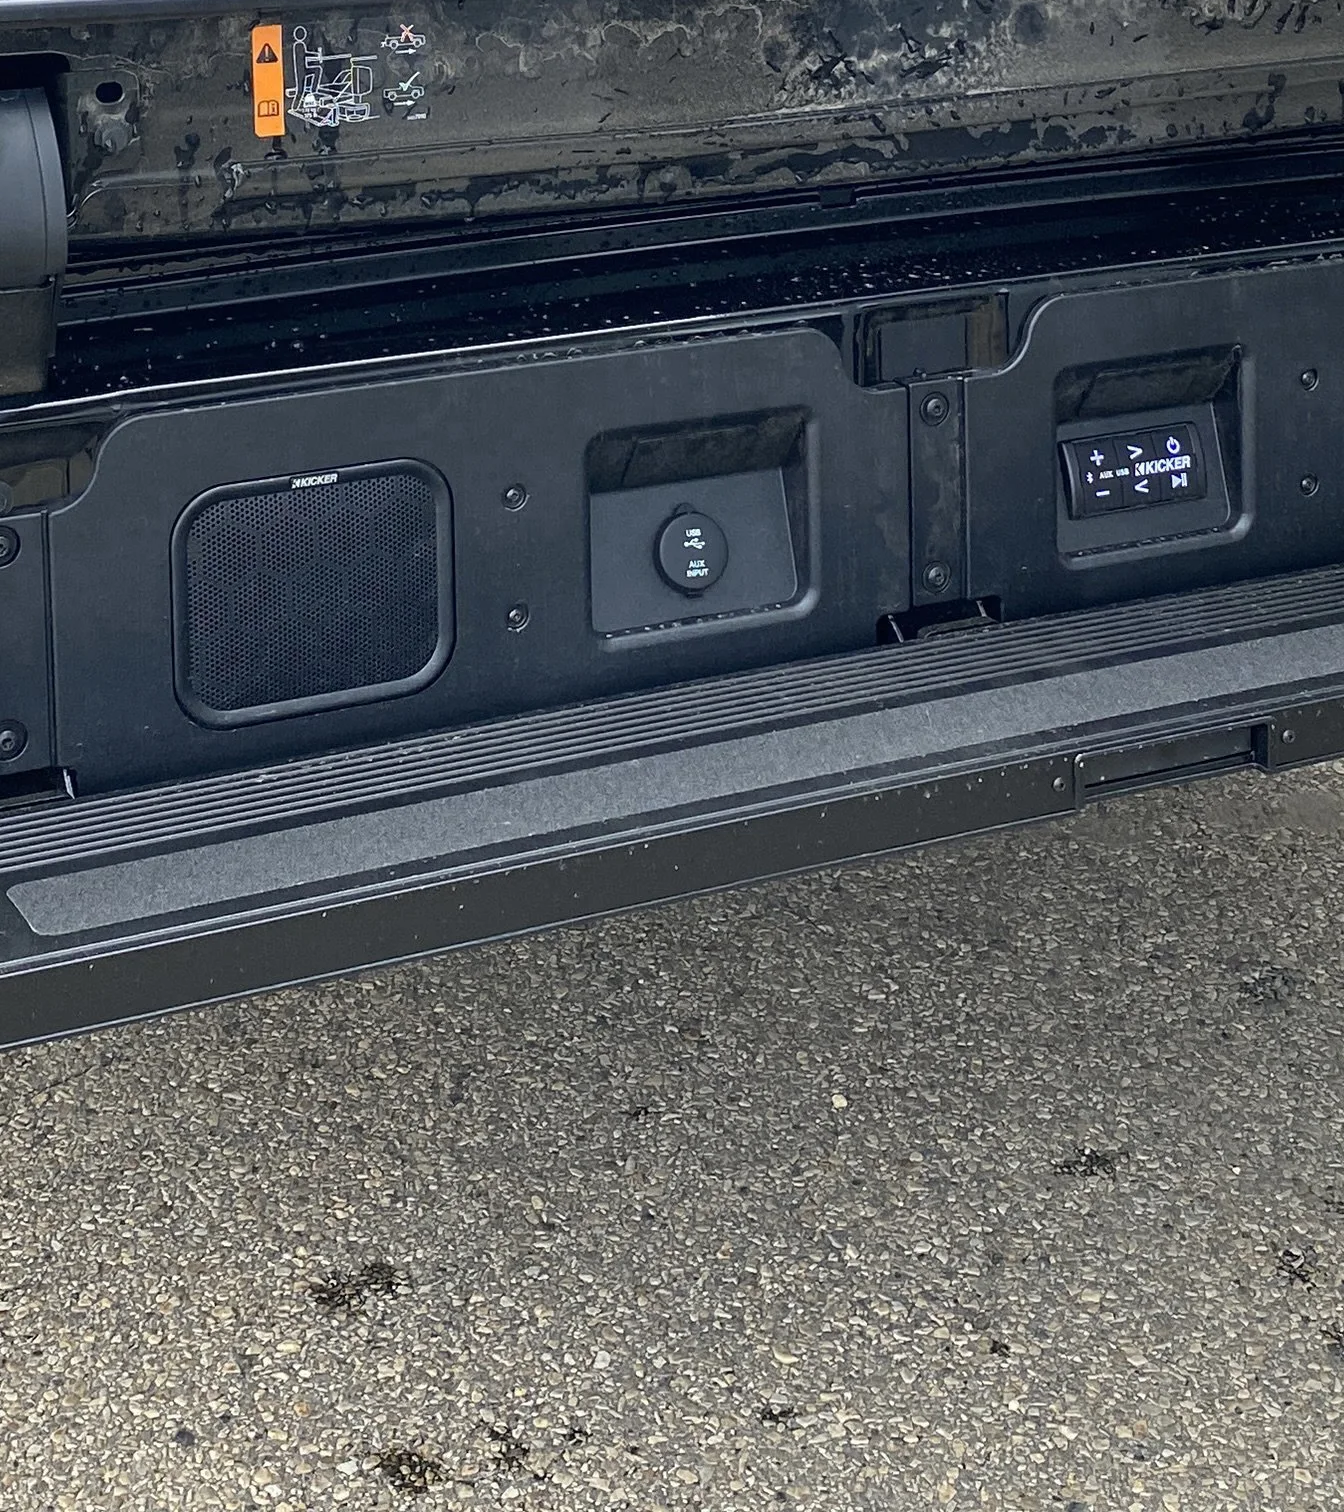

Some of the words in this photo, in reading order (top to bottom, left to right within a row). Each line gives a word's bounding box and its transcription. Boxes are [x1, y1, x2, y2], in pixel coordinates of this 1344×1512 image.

[1099, 469, 1114, 480] AUX
[1144, 455, 1191, 475] KICKER
[300, 473, 338, 488] KICKER
[685, 528, 702, 537] USB
[688, 559, 706, 569] AUX
[686, 567, 709, 578] INPUT
